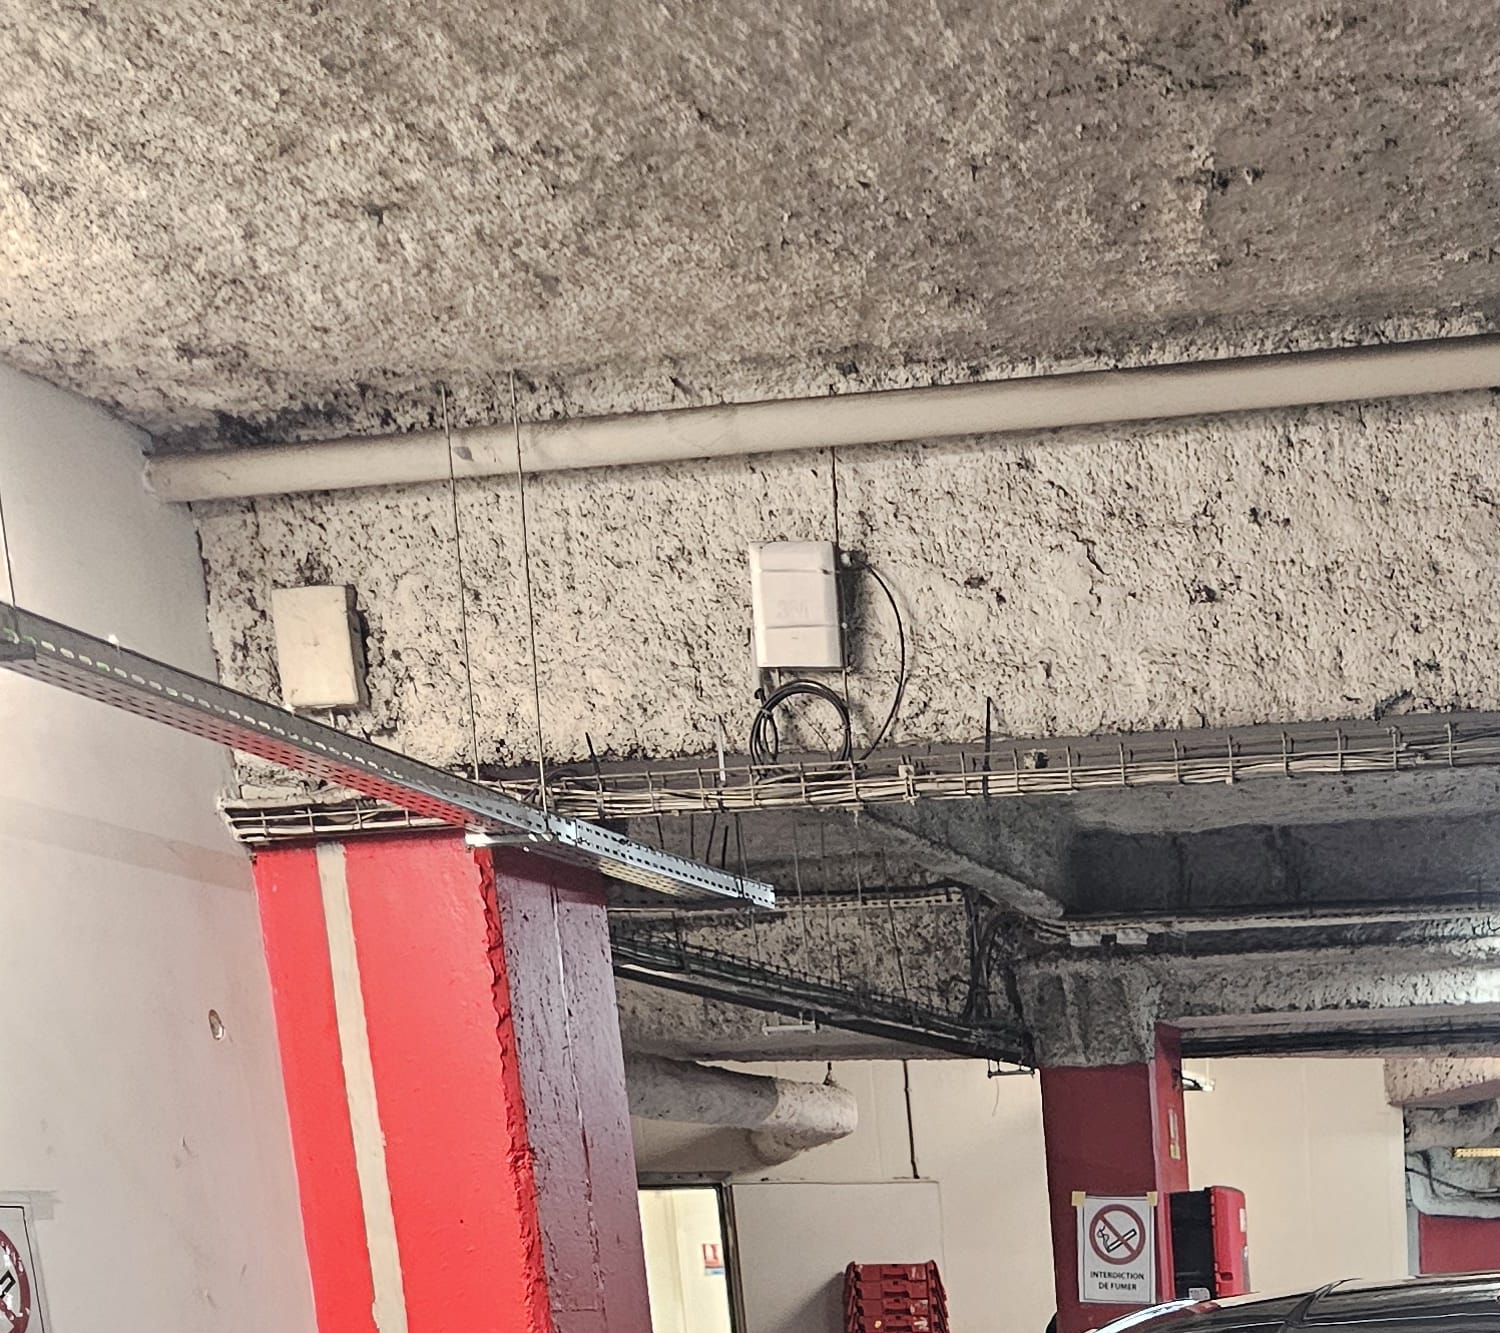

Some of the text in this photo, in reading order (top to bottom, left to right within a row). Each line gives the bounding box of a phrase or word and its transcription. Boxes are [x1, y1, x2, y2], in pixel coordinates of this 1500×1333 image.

[1090, 1271, 1145, 1281] INTERDICTION
[1098, 1282, 1137, 1291] DE FUMER
